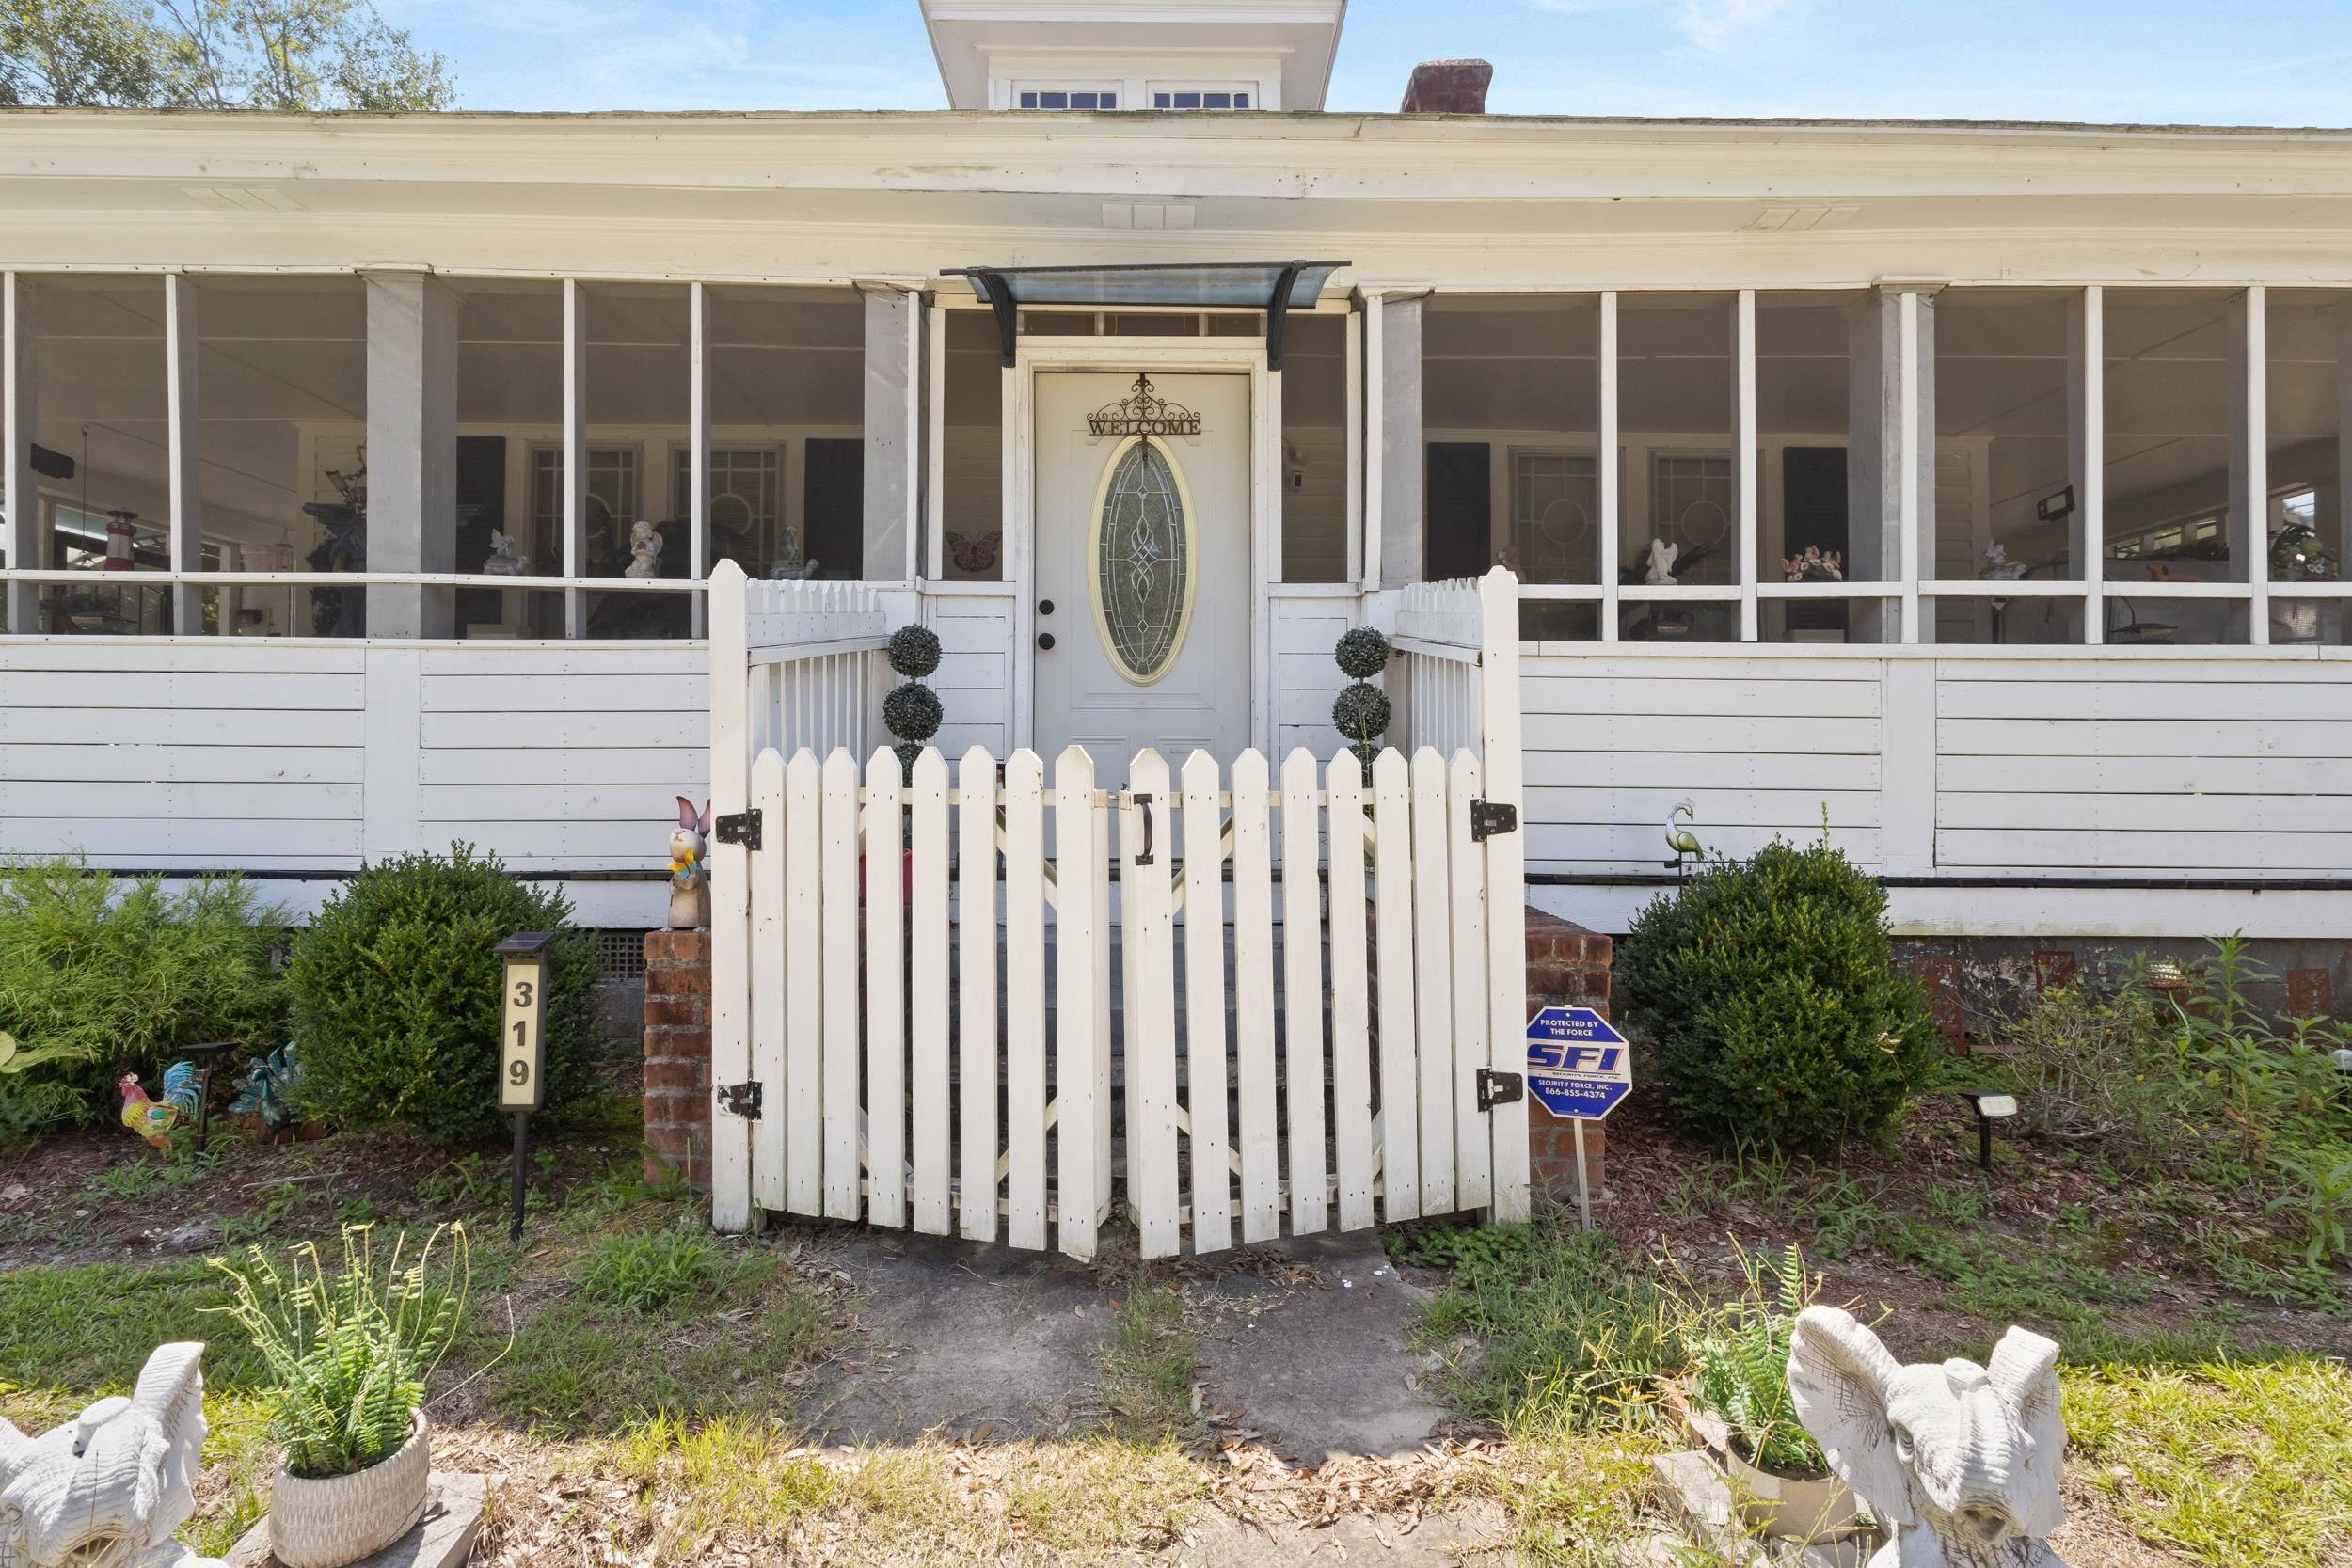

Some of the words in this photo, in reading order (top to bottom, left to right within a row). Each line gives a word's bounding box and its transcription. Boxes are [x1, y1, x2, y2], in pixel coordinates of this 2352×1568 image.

[1089, 420, 1201, 436] WELCOME
[509, 981, 533, 1086] 319
[1527, 1044, 1623, 1072] SFI
[1538, 1079, 1569, 1088] SECURITY
[1570, 1082, 1595, 1090] FORCE,
[1545, 1087, 1606, 1099] 866-855-4374
